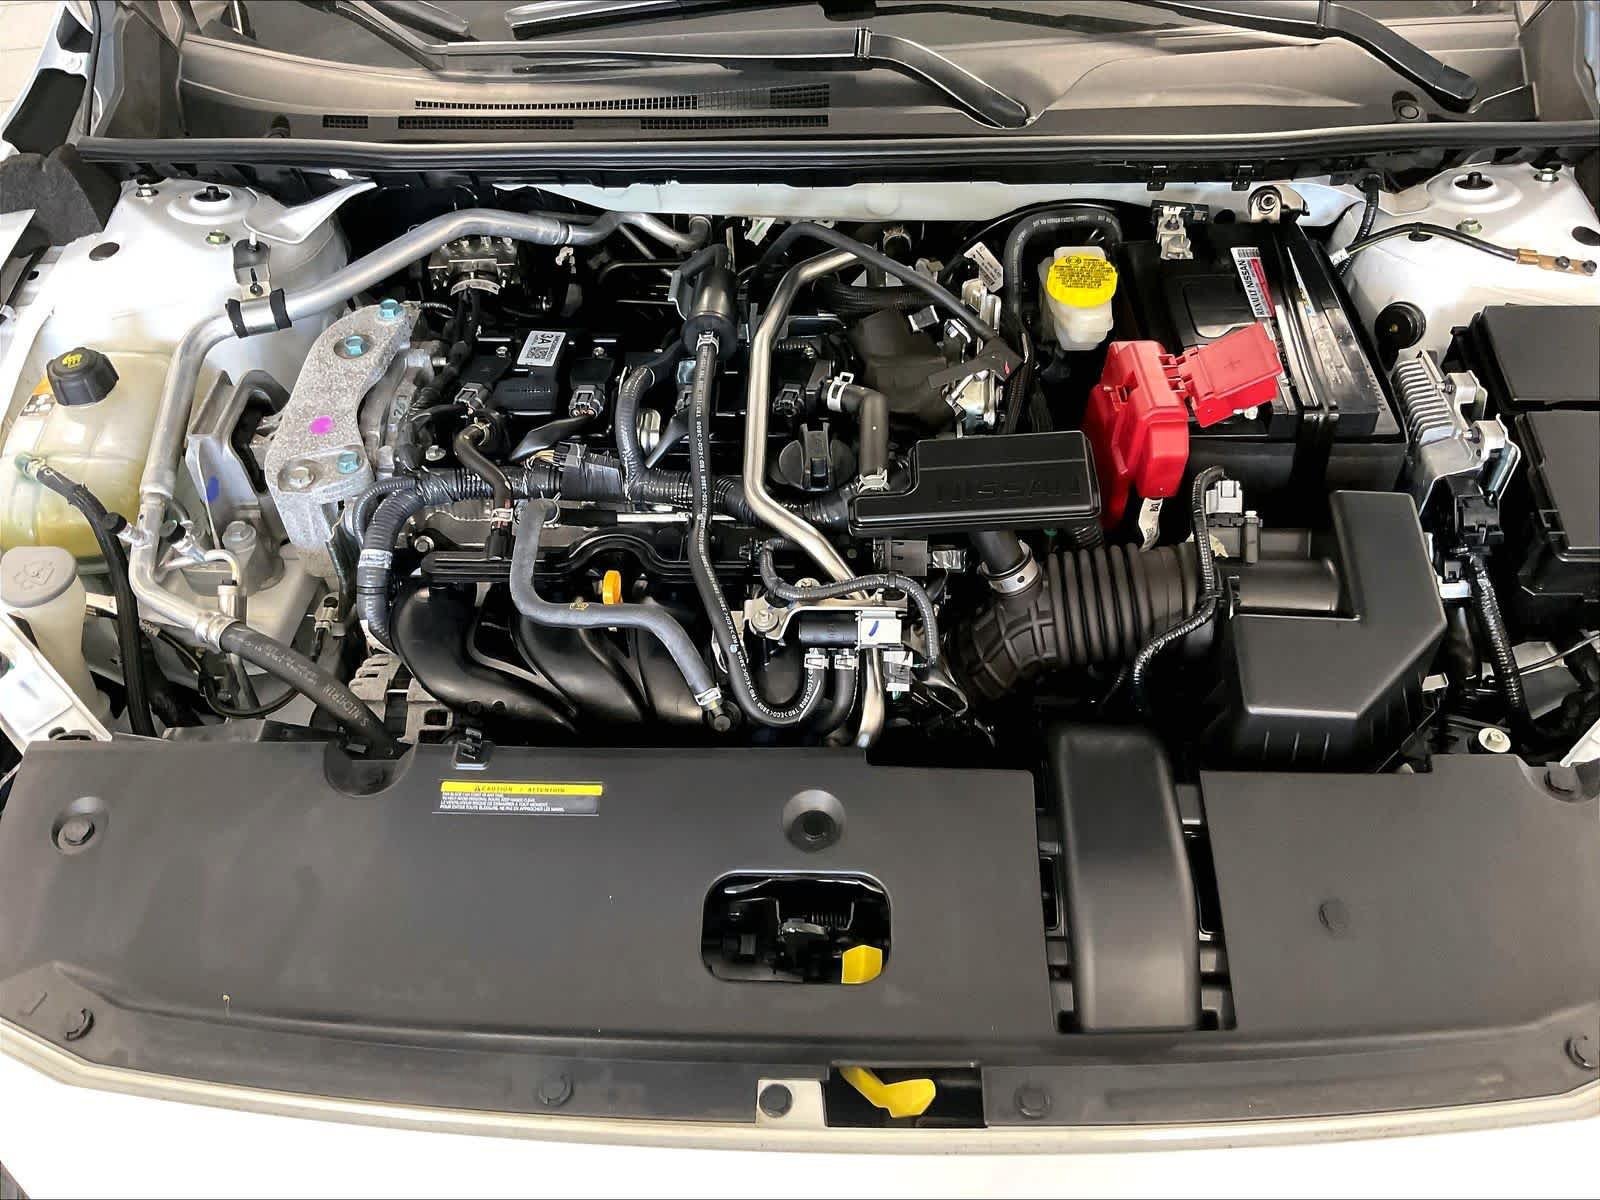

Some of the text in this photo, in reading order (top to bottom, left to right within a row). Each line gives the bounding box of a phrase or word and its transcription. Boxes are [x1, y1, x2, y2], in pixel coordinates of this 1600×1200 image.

[1238, 259, 1255, 287] NISSAN
[538, 333, 554, 344] 3A
[936, 474, 1082, 503] NISSAN
